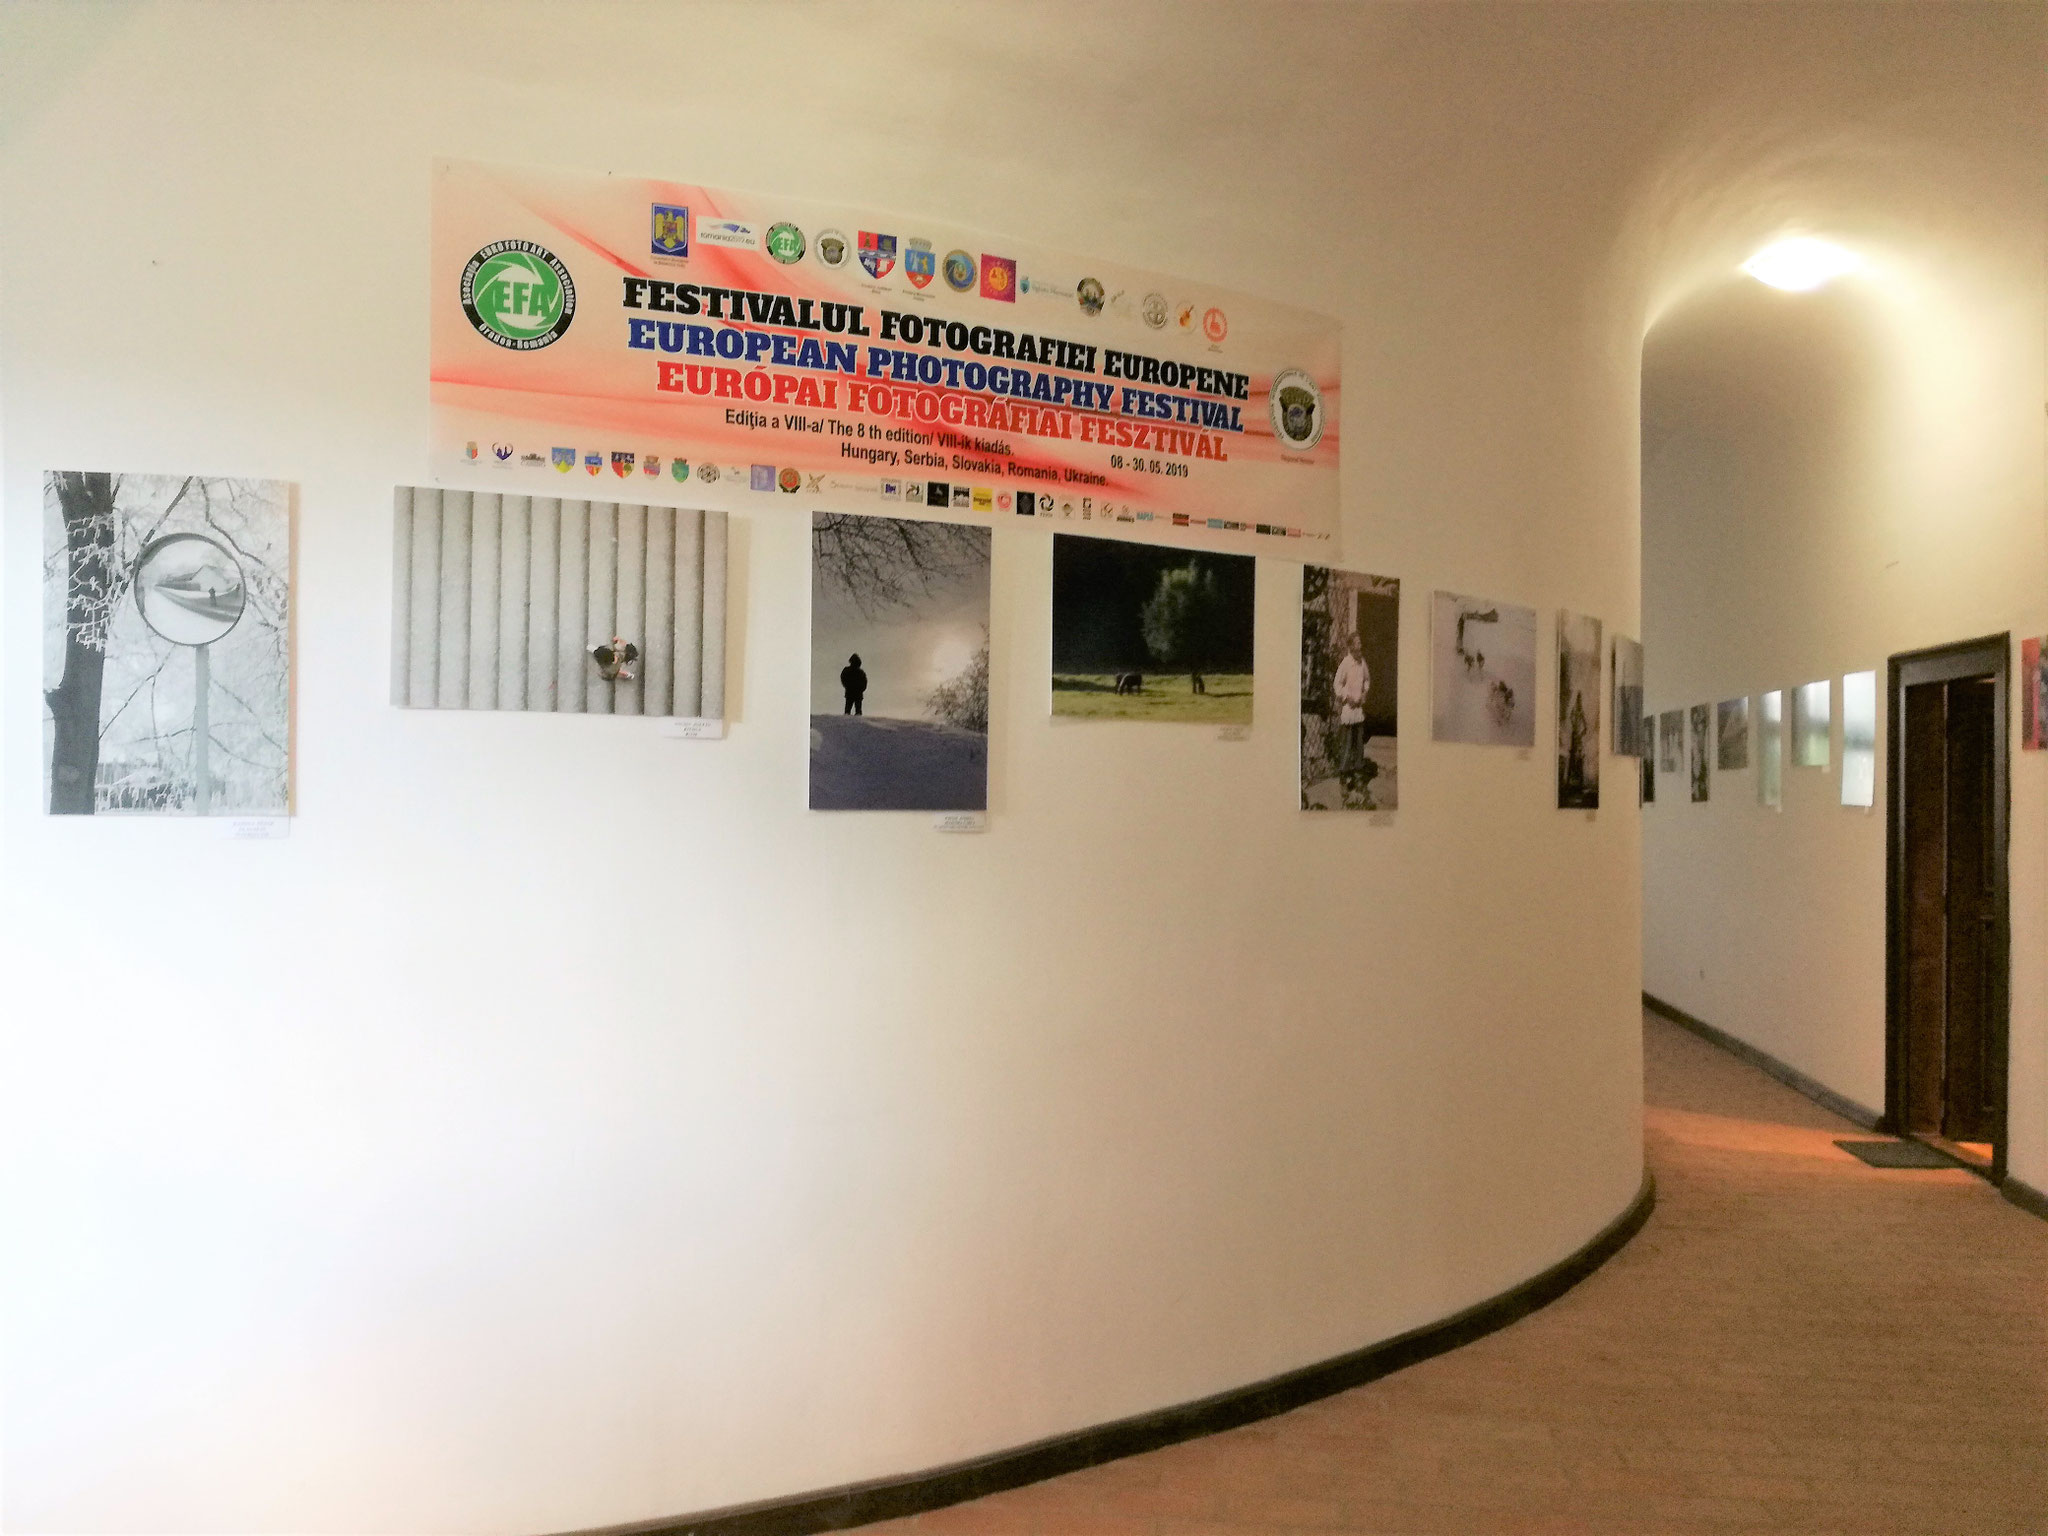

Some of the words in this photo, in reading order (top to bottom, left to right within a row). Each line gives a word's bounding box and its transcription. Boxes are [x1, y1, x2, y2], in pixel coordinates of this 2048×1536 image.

[494, 281, 547, 317] EFA
[623, 277, 870, 336] FESTIVALUL
[880, 309, 1097, 374] FOTOGRAFIEI
[1103, 349, 1249, 400] EUROPENE
[628, 317, 858, 374] EUROPEAN
[867, 346, 1114, 412] PHOTOGRAPHY
[1121, 386, 1244, 432] FESTIVAL
[657, 361, 838, 410] EURÓPAI
[848, 382, 1072, 440] FOTOGRÁFIAI
[1080, 415, 1228, 462] FESZTIVÁL
[771, 417, 780, 429] a
[828, 419, 853, 437] The
[857, 423, 865, 439] 8
[869, 425, 882, 440] th
[885, 427, 934, 446] edition/
[974, 437, 1014, 456] kiadás.
[841, 442, 900, 467] Hungary,
[904, 449, 948, 470] Serbia,
[952, 455, 1005, 478] Slovakia,
[1008, 462, 1061, 483] Romania,
[1064, 469, 1109, 487] Ukraine.
[1110, 454, 1123, 469] 08
[1132, 457, 1147, 473] 30.
[1150, 460, 1163, 475] 05.
[1165, 462, 1189, 478] 2019
